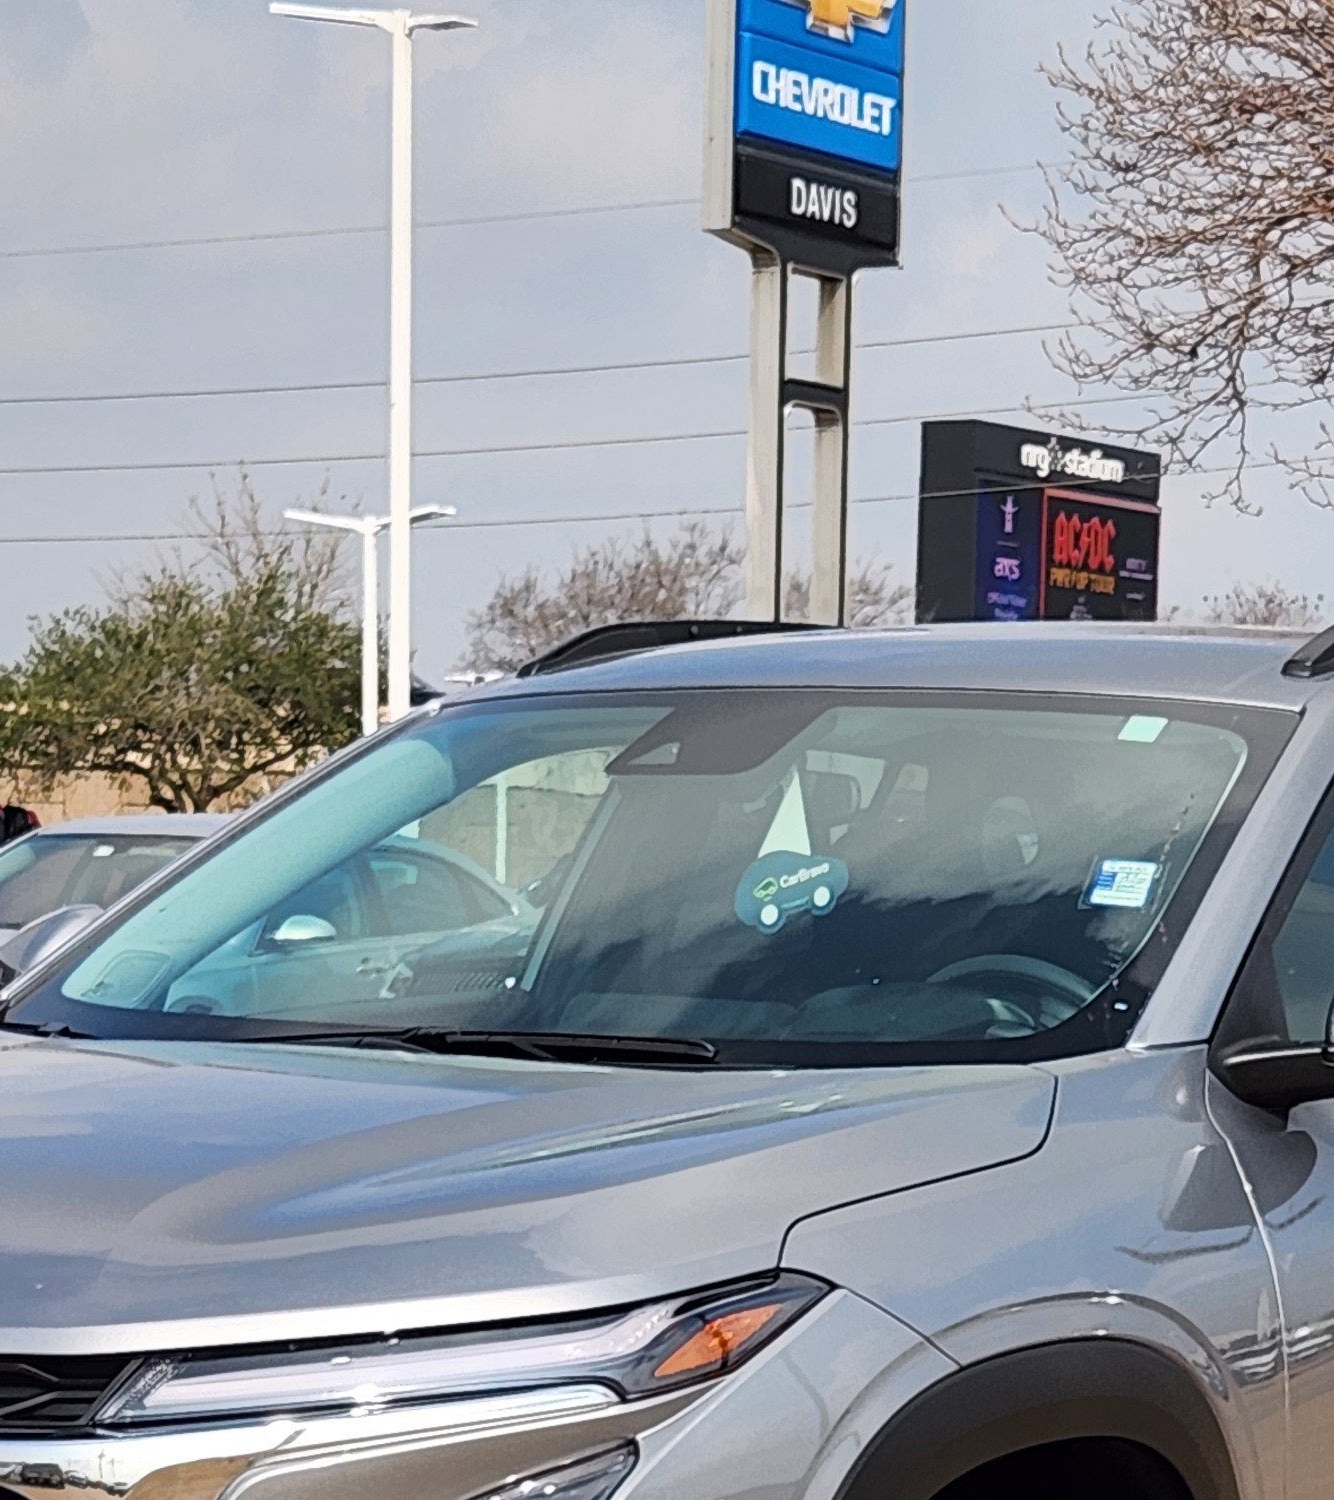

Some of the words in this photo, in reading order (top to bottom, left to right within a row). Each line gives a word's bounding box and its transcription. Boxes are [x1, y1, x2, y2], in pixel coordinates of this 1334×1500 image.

[752, 60, 897, 136] CHEVROLET
[791, 177, 858, 229] DAVIS
[1052, 510, 1117, 574] AC/DC
